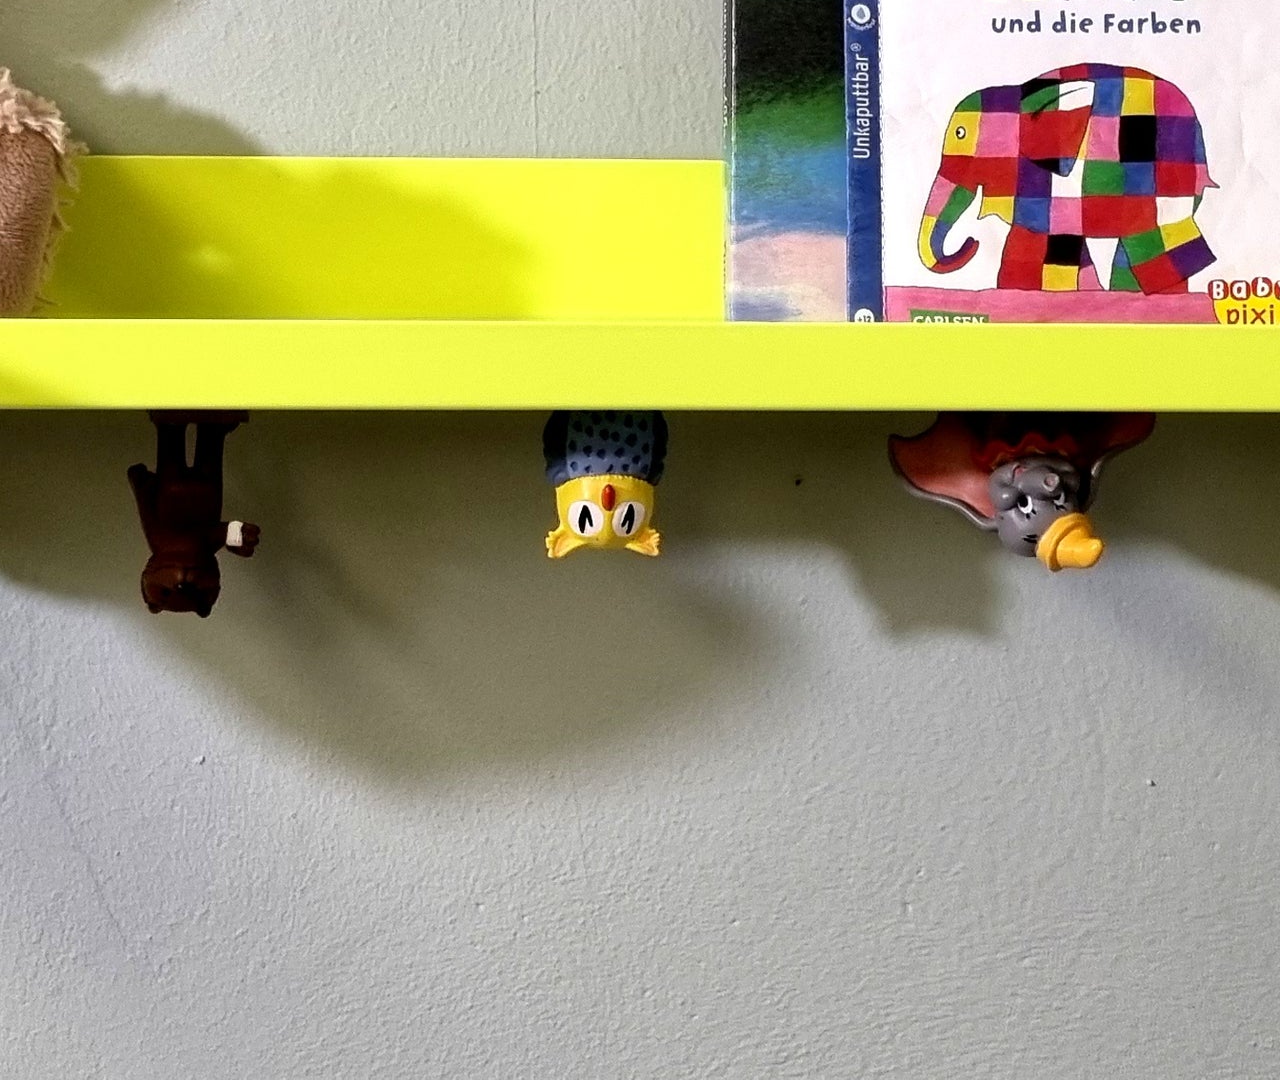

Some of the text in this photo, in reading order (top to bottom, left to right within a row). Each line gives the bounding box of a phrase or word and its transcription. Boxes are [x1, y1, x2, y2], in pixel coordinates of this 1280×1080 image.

[991, 10, 1202, 34] und die Farben
[1226, 304, 1274, 324] pixi
